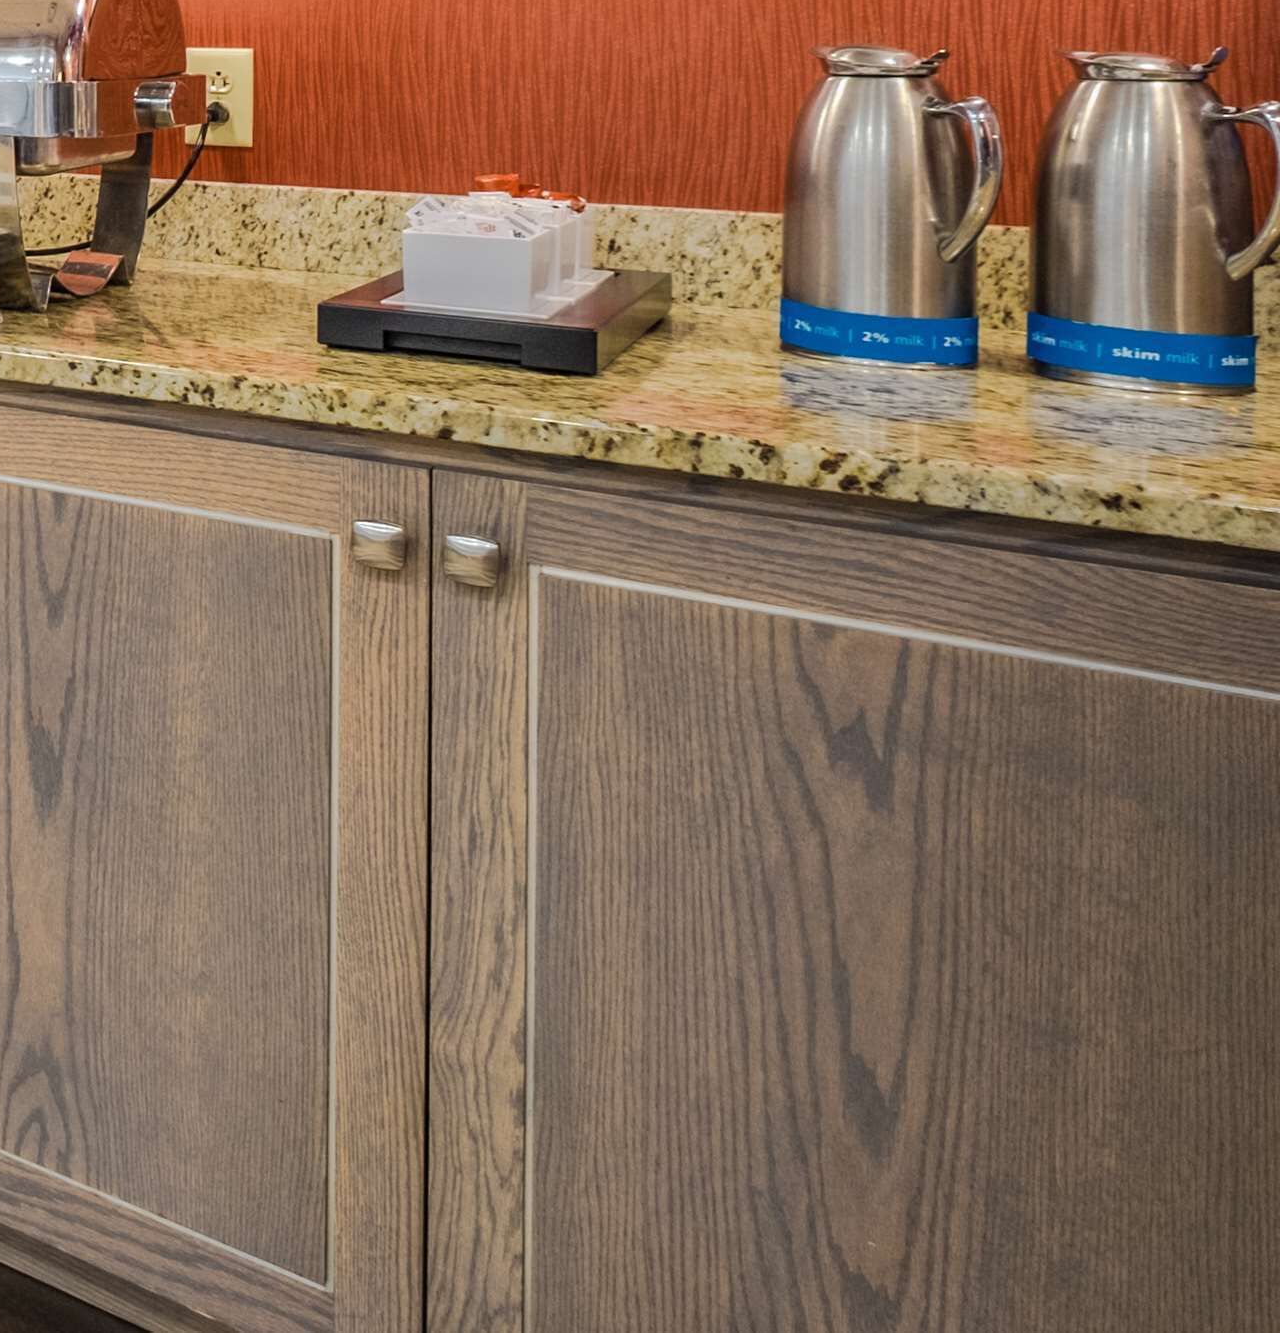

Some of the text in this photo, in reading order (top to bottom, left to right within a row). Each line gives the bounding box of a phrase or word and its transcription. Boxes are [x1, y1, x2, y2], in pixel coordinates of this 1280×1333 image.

[794, 319, 813, 332] 2%
[814, 324, 841, 339] milk
[861, 331, 890, 344] 2%
[894, 334, 925, 346] milk
[943, 336, 963, 348] 2%
[1031, 331, 1057, 347] skim
[1058, 338, 1089, 353] milk
[1111, 346, 1161, 362] skim
[1165, 353, 1200, 365] milk
